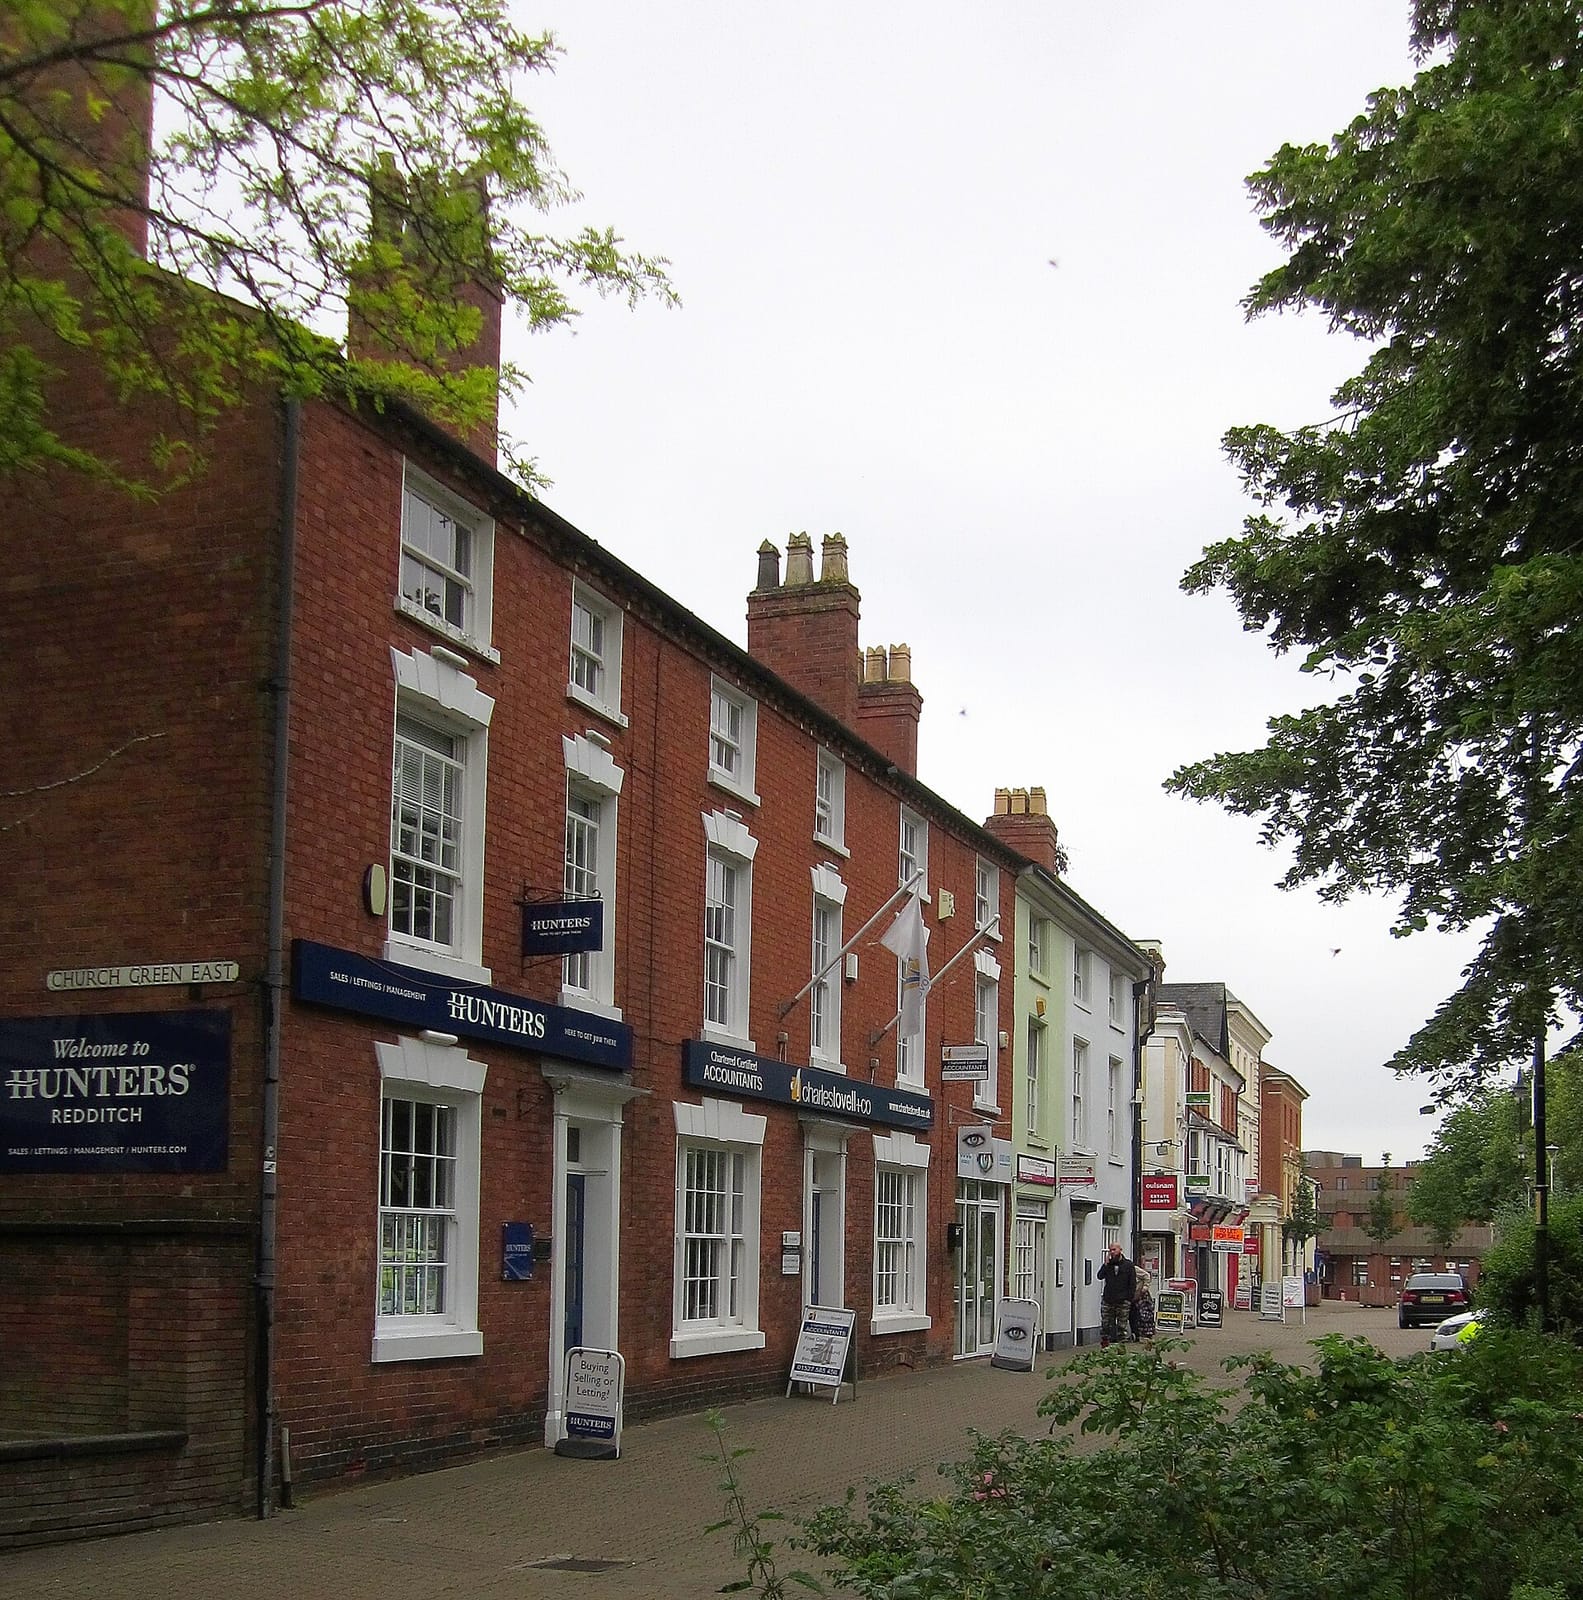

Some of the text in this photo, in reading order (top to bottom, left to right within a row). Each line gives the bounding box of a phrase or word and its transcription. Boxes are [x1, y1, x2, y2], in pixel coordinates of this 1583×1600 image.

[531, 917, 590, 930] HUNTERS
[52, 964, 234, 988] CHURCH GREEN EAST
[330, 972, 348, 983] SALES
[354, 976, 382, 991] LETTINGS
[386, 985, 426, 1000] MANAGEMENT
[448, 992, 545, 1038] HUNTERS
[564, 1028, 576, 1037] HERE
[577, 1030, 583, 1039] TO
[584, 1032, 592, 1040] GET
[53, 1038, 150, 1058] Welcome to
[711, 1051, 757, 1072] Chartered Certified
[5, 1064, 190, 1099] HUNTERS
[704, 1065, 763, 1091] ACCOUNTANTS
[51, 1108, 142, 1124] REDDITCH
[805, 1326, 846, 1336] ACCOUNTANTS
[581, 1360, 609, 1375] Buying
[574, 1373, 600, 1387] Selling
[570, 1417, 612, 1429] HUNTERS
